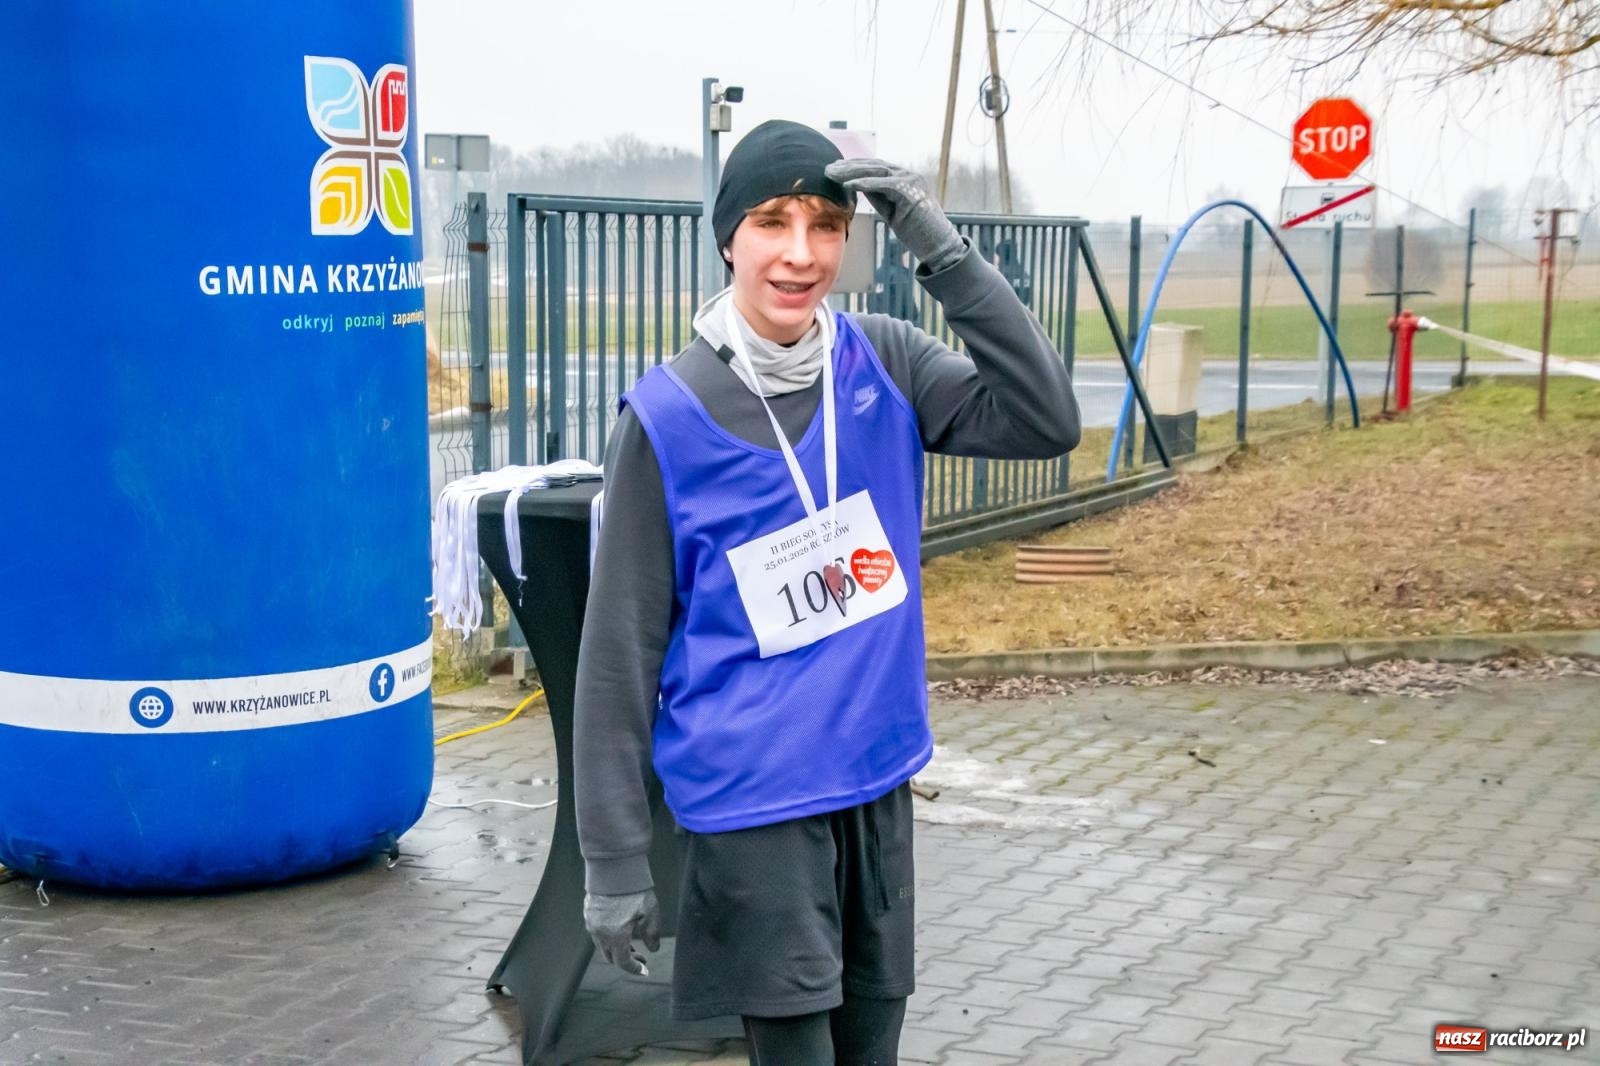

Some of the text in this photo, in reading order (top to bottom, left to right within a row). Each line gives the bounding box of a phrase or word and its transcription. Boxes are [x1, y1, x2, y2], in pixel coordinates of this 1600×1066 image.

[1300, 125, 1367, 154] STOP
[1333, 211, 1372, 222] ruchu
[199, 255, 424, 296] GMINA KRZYŻANO
[282, 313, 333, 333] odkryj
[345, 311, 385, 331] poznaj
[770, 545, 779, 556] II
[780, 535, 802, 552] BIEG
[764, 546, 809, 571] 25.01.2026
[192, 689, 331, 715] WWW.KRZYŻANOWICE.PL
